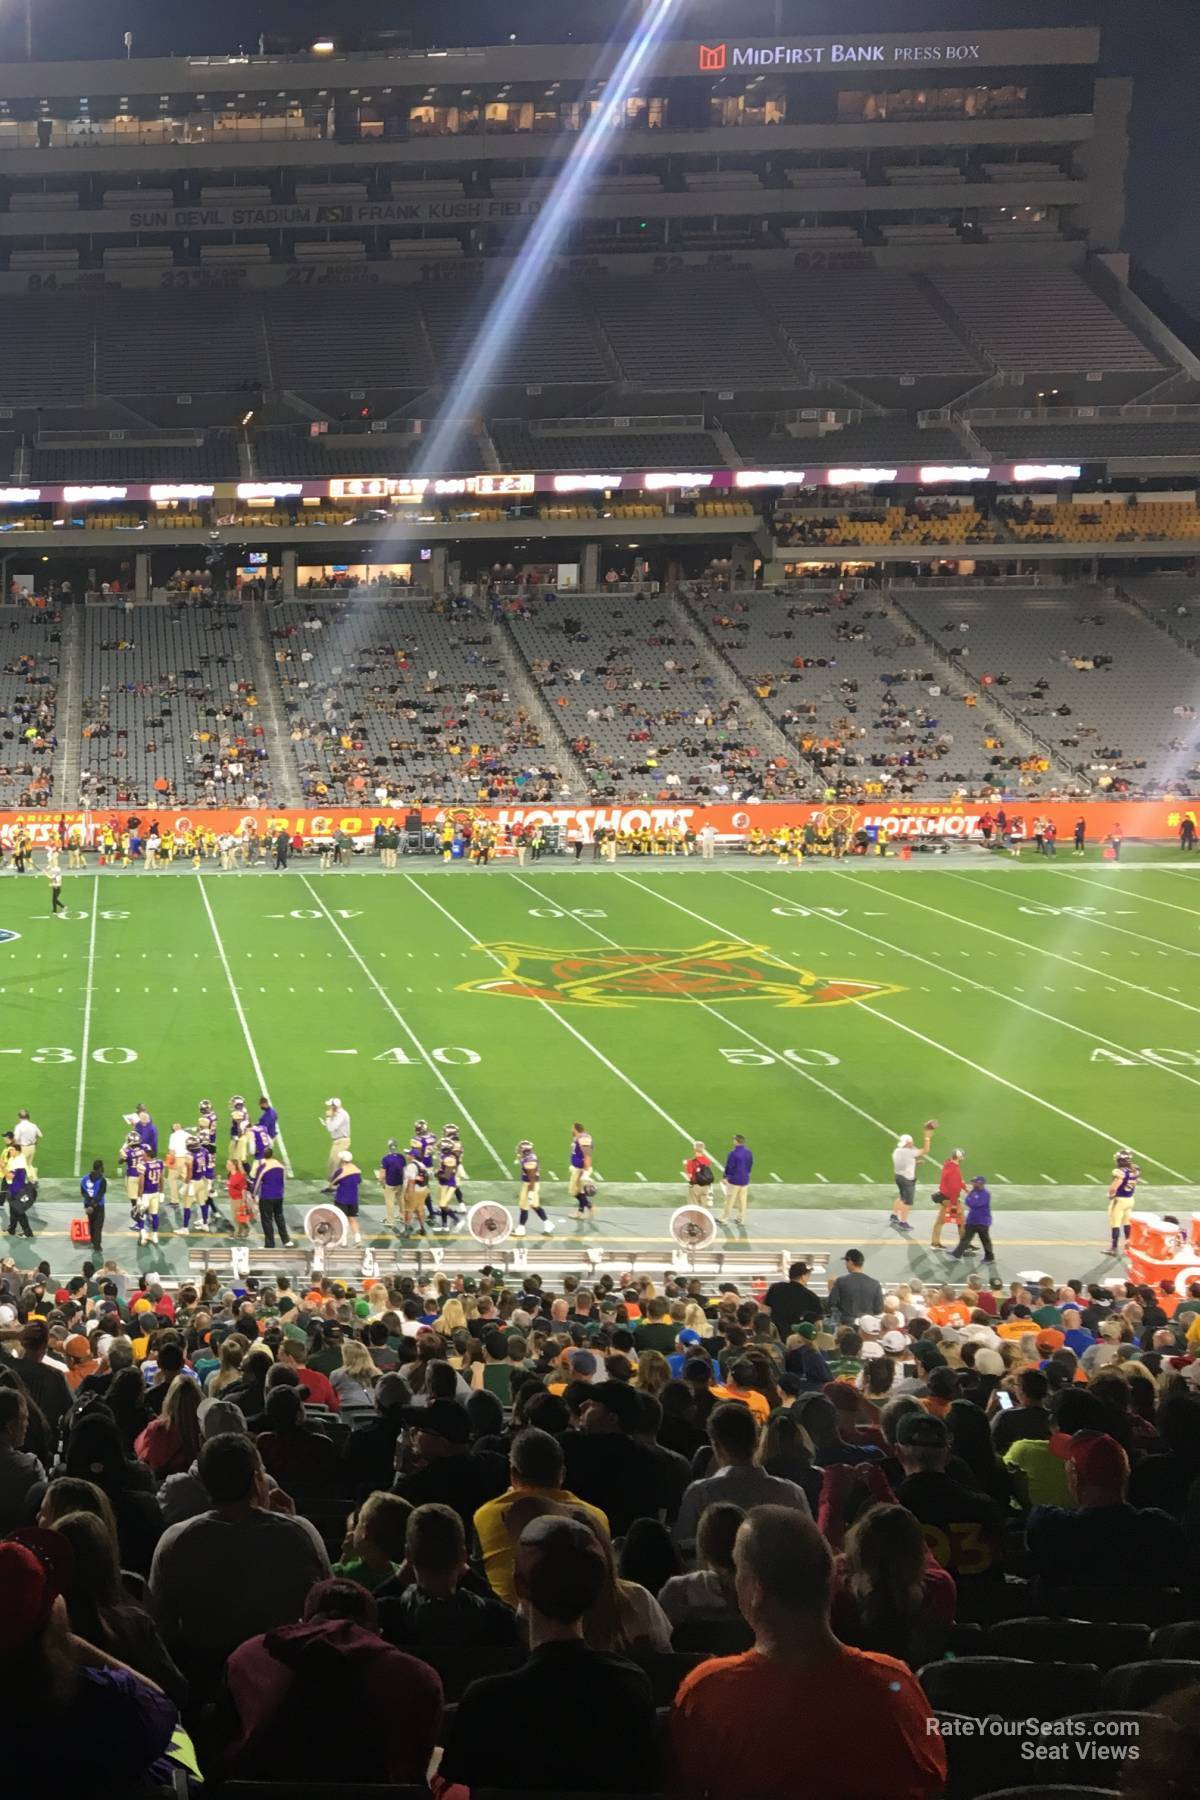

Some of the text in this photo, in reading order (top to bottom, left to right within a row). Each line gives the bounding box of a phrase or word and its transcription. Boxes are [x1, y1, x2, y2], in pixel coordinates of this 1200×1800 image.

[894, 47, 942, 61] PRESS
[946, 45, 980, 60] BOX
[129, 213, 169, 228] SUN
[175, 210, 224, 226] DEVIL
[232, 208, 311, 224] STADIUM
[358, 205, 419, 221] FRANK
[428, 202, 481, 218] KUSH
[27, 274, 57, 290] 84
[161, 271, 191, 289] 33
[286, 267, 315, 285] 27
[30, 1046, 139, 1065] 30
[371, 1046, 482, 1065] 40
[718, 1047, 841, 1066] 50
[1090, 1046, 1200, 1066] 40
